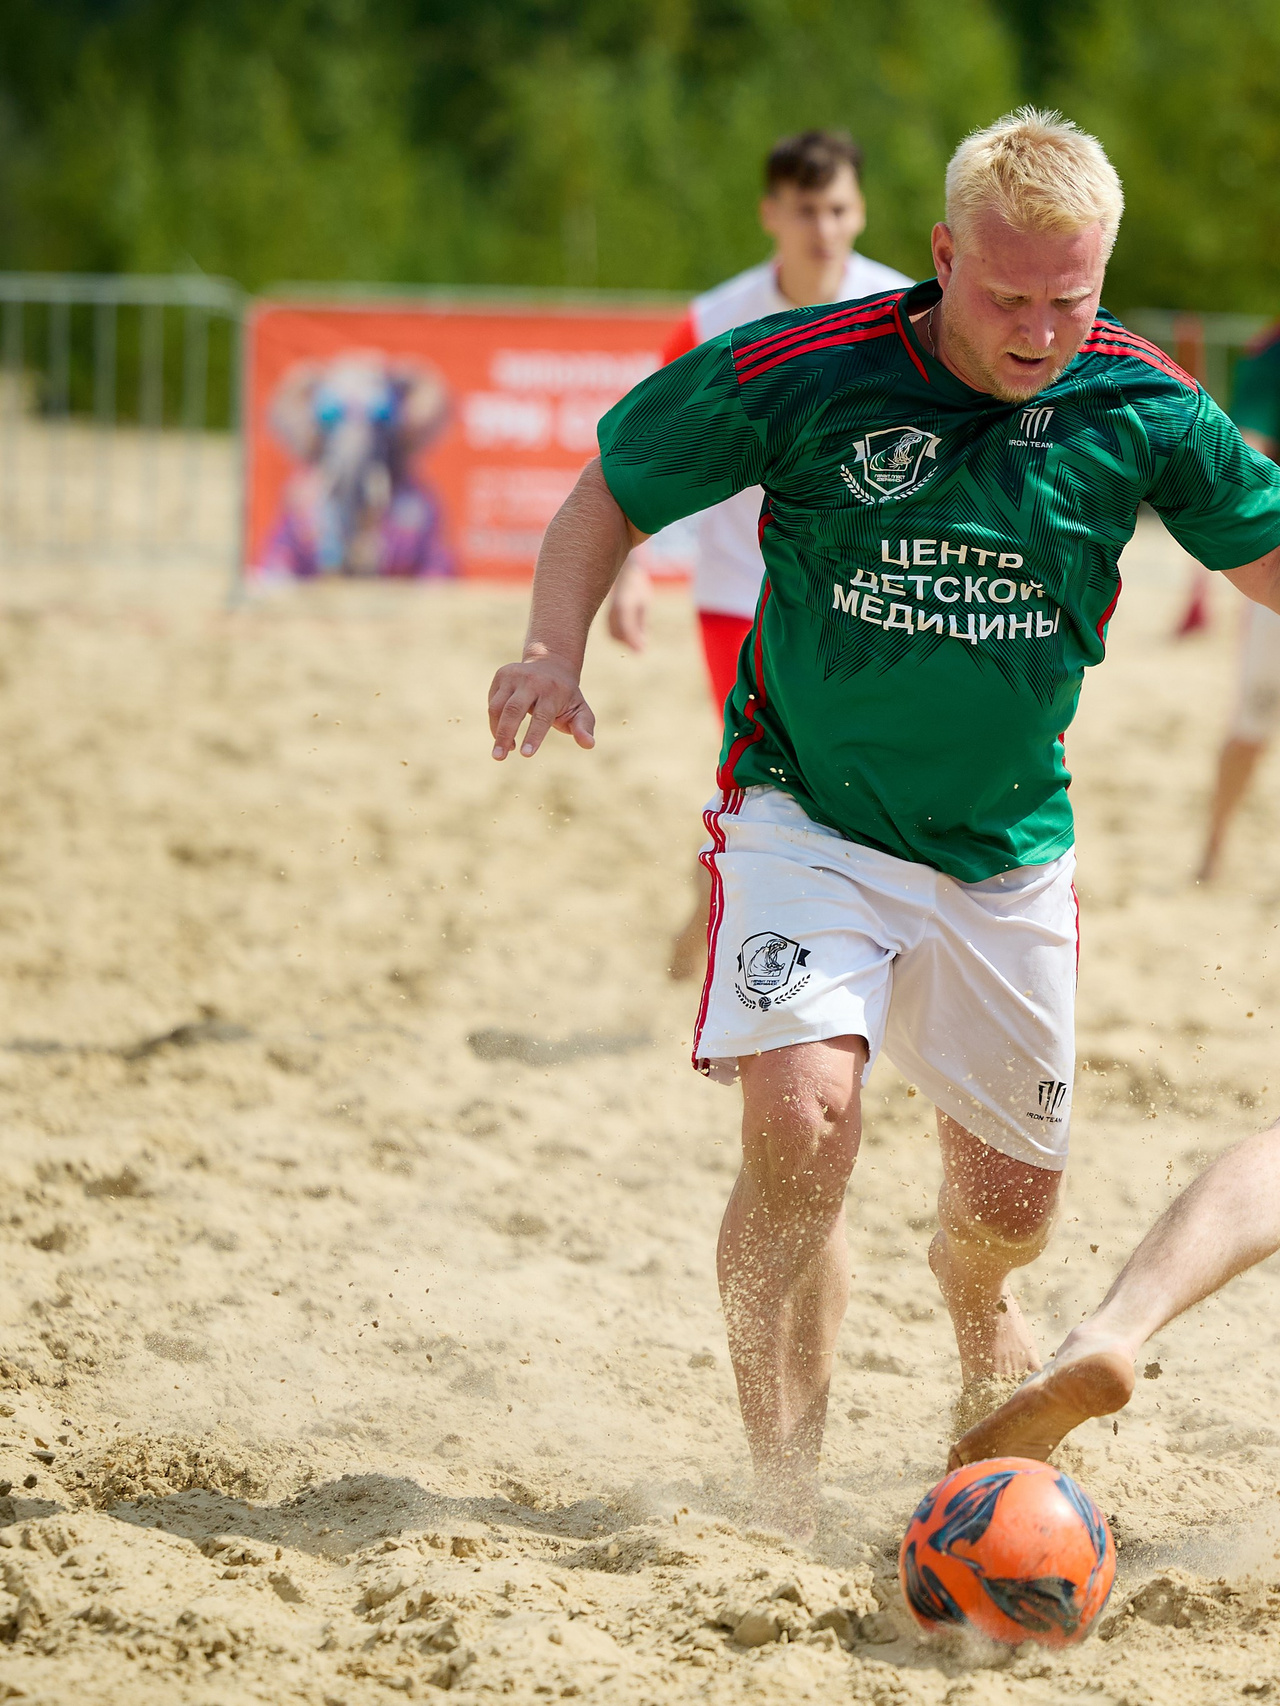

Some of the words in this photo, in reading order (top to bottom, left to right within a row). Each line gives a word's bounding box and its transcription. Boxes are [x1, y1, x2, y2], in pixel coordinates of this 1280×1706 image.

[1008, 439, 1028, 447] IRON
[1029, 441, 1054, 449] TEAM
[881, 538, 1024, 569] ЦЕНТР
[849, 568, 1046, 603] ДЕТСКОЙ
[832, 583, 1061, 645] МЕДИЦИНЫ
[1026, 1112, 1044, 1121] IRON
